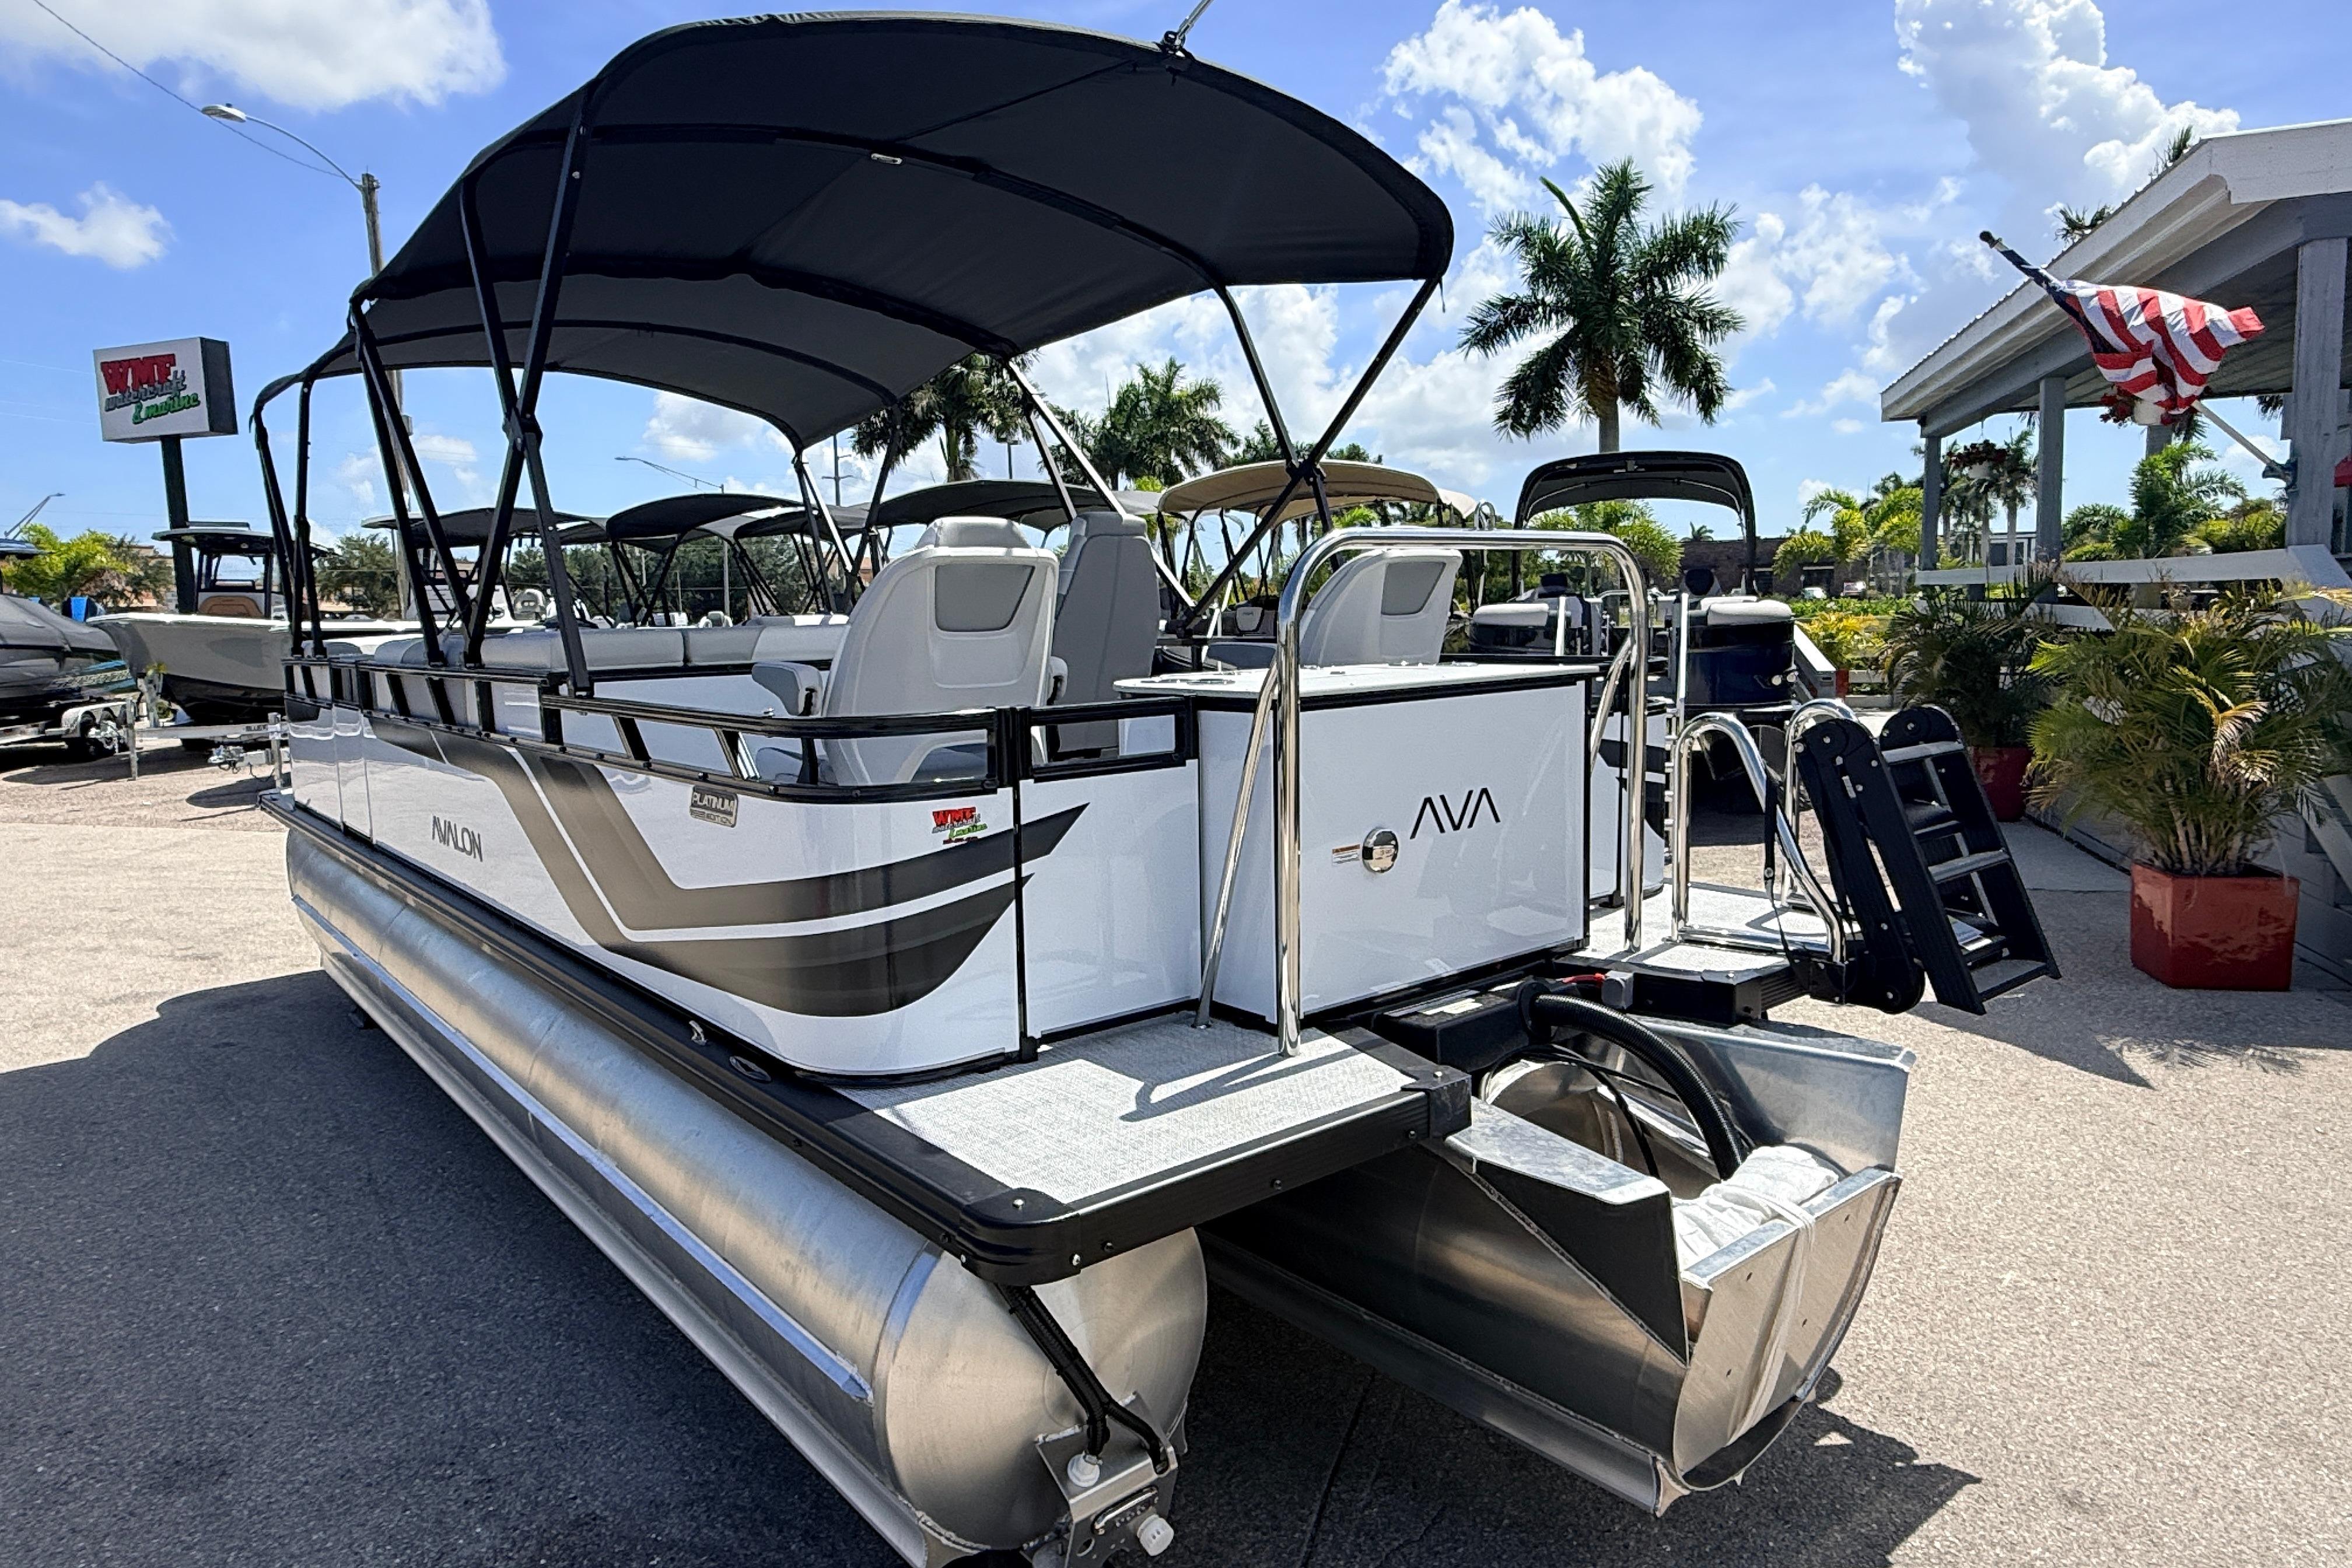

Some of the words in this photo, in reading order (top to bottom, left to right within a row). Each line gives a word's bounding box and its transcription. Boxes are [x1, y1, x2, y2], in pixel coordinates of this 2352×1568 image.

[692, 792, 734, 811] PLATINUM
[1409, 788, 1501, 839] AVA
[432, 816, 483, 862] AVALON
